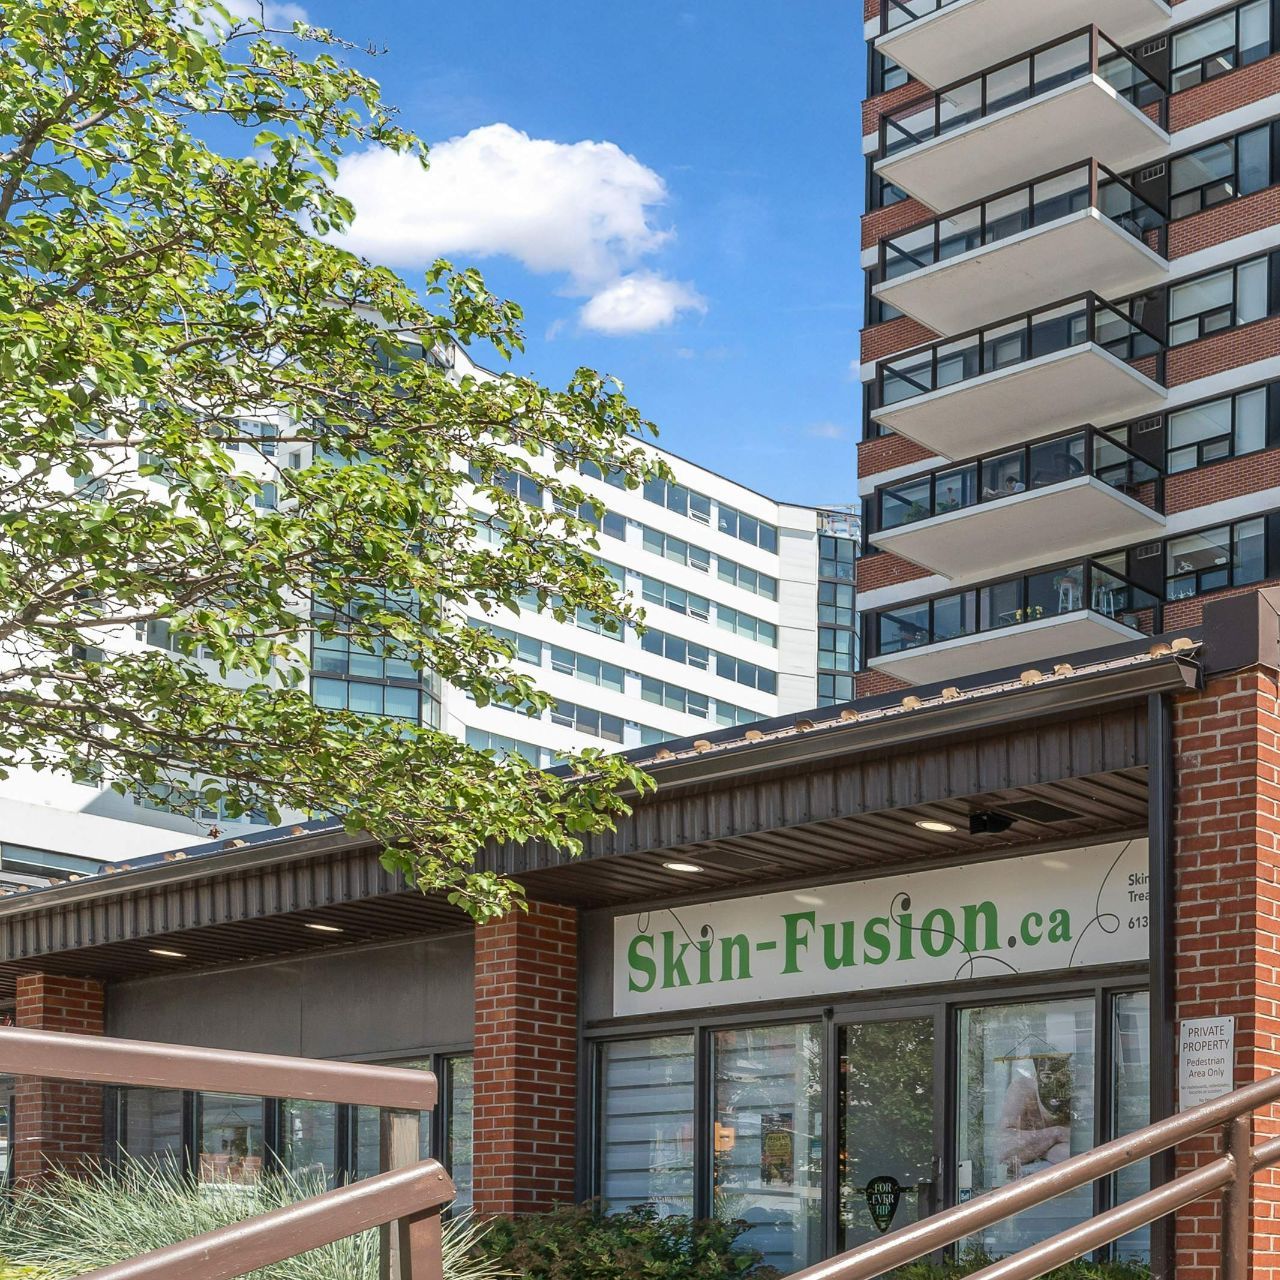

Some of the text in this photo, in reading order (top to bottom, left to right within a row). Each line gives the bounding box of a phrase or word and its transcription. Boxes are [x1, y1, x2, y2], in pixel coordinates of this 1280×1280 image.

[1128, 916, 1148, 929] 613
[627, 897, 1073, 993] Skin-Fusion.ca
[1188, 1025, 1225, 1037] PRIVATE
[1182, 1039, 1230, 1053] PROPERTY
[1186, 1057, 1225, 1067] Pedestrian
[1188, 1068, 1225, 1078] Area Only
[874, 1183, 892, 1193] FOR
[872, 1194, 894, 1205] EVER
